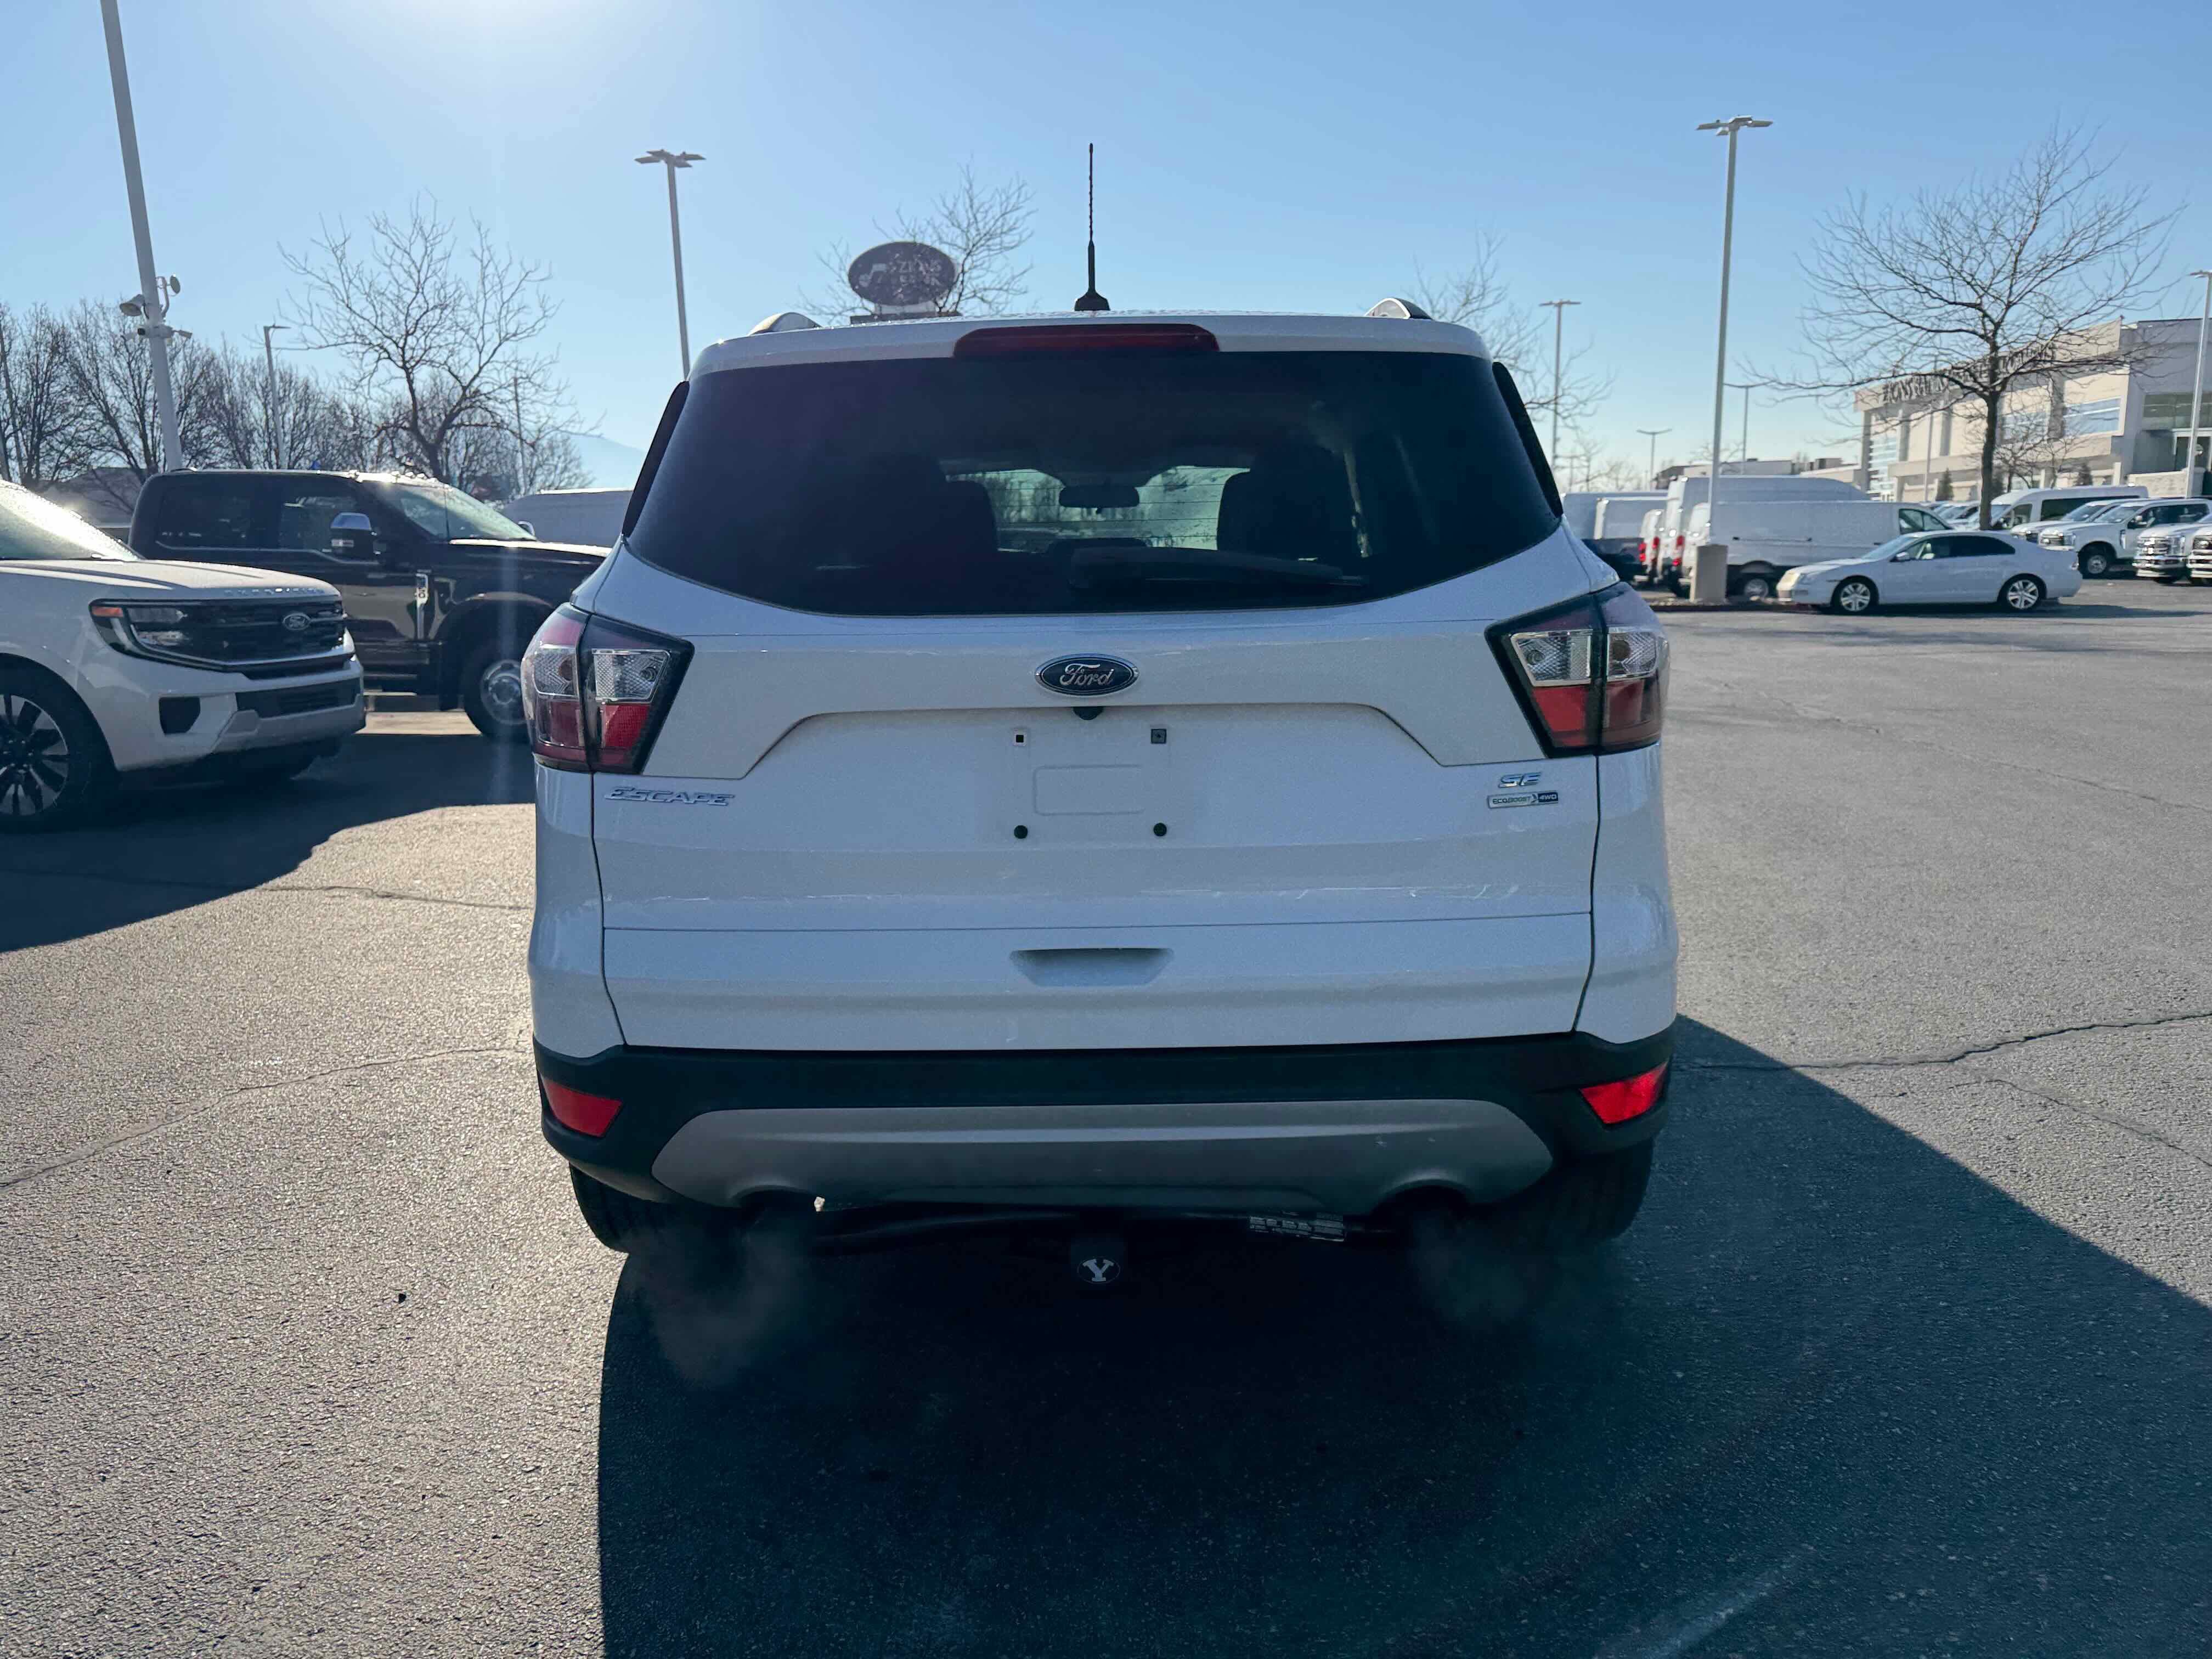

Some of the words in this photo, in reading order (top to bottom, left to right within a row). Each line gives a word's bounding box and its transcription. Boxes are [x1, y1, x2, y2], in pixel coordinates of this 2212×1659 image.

[1059, 663, 1115, 686] Ford
[1498, 771, 1542, 788] SE
[605, 786, 736, 806] ESCAPE
